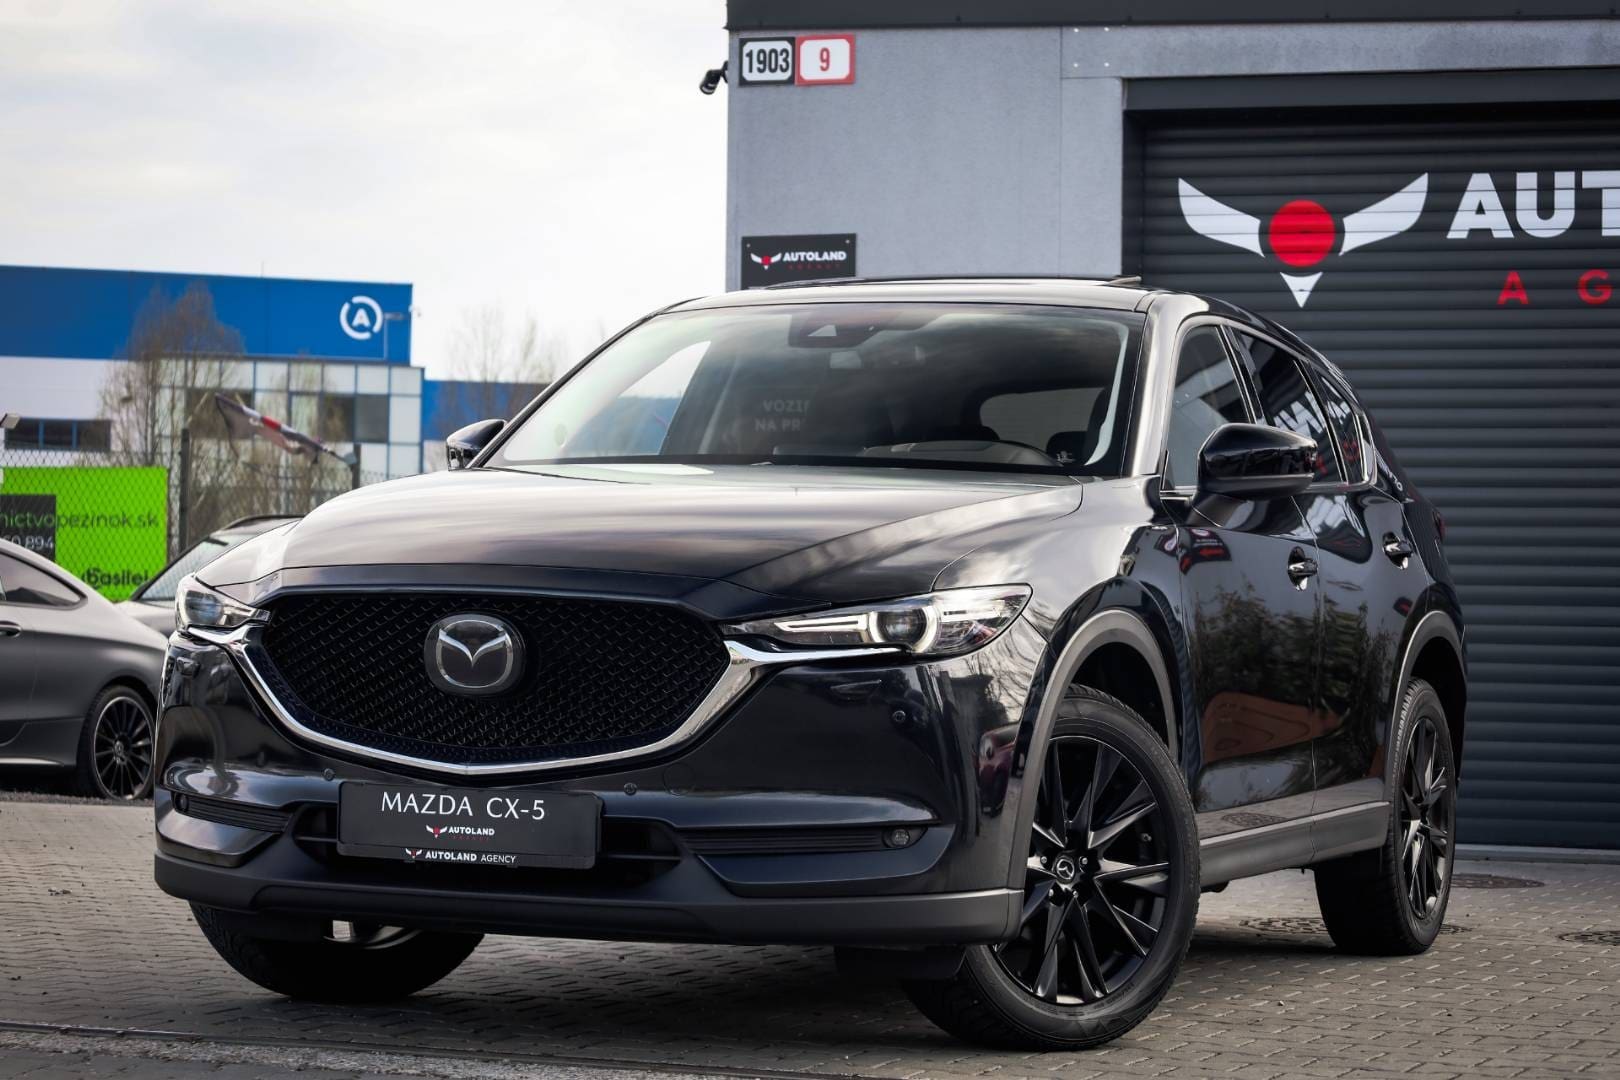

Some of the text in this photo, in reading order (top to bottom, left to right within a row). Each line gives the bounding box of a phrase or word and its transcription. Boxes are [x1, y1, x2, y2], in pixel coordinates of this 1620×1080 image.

[745, 48, 790, 74] 1903
[820, 47, 830, 72] 9
[1446, 170, 1620, 240] AUT
[782, 251, 847, 262] AUTOLAND
[754, 417, 806, 432] NA PR
[381, 791, 545, 820] MAZDA CX-5
[448, 826, 495, 837] AUTOLAND
[425, 850, 516, 864] AUTOLAND AGENCY
